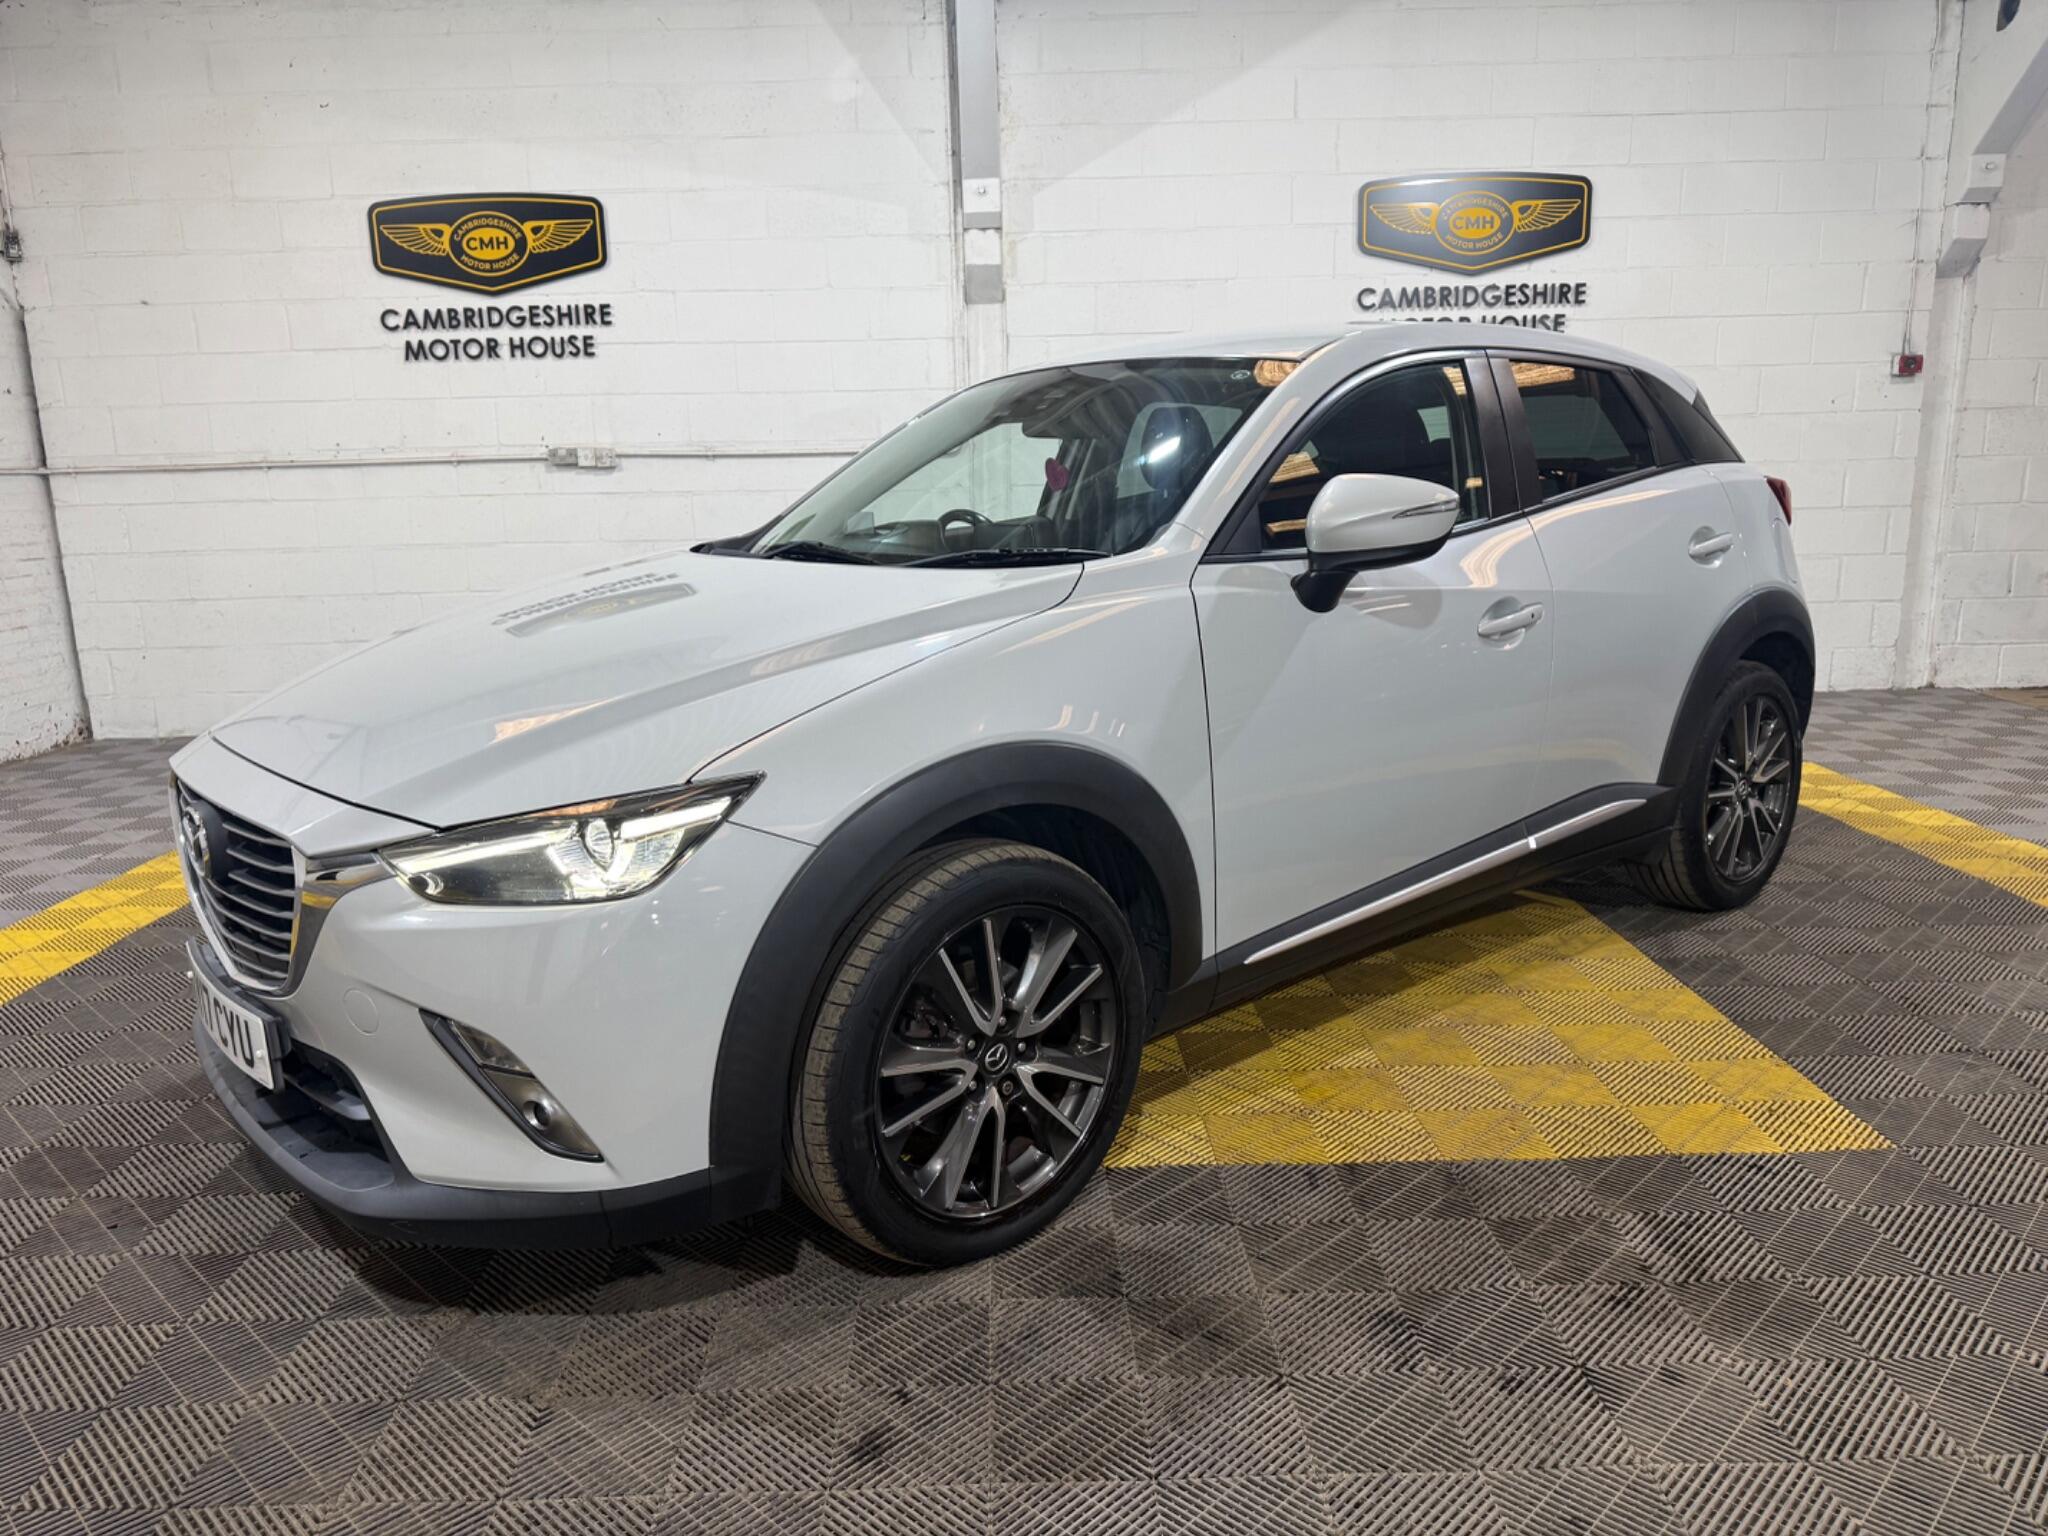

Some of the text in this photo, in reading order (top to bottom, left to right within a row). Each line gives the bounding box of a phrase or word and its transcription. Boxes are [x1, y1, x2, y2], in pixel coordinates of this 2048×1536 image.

[454, 217, 522, 240] CAMBRIDGESHIRE
[1453, 215, 1495, 230] CMH
[466, 236, 509, 251] CMH
[1445, 232, 1503, 248] MOTOR HOUSE
[461, 252, 520, 270] MOTOR HOUSE
[1357, 283, 1587, 311] CAMBRIDGESHIRE
[380, 304, 612, 332] CAMBRIDGESHIRE
[405, 335, 595, 361] MOTOR HOUSE
[213, 997, 255, 1069] CYU
